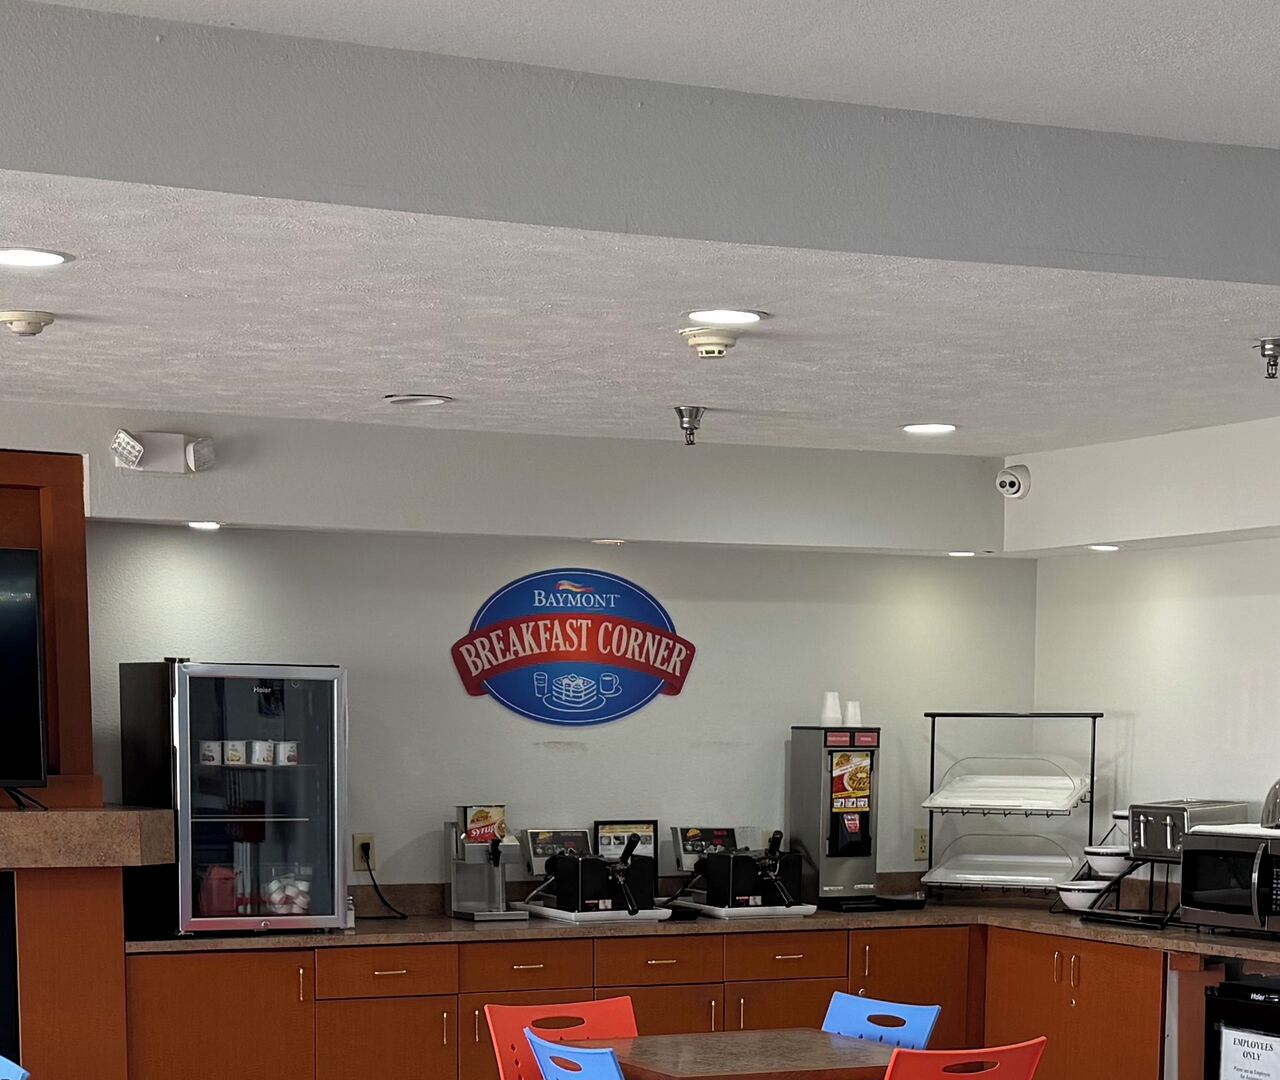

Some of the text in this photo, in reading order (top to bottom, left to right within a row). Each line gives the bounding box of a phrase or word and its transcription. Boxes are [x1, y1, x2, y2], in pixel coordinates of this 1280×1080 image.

[533, 590, 617, 607] BAYMONT
[458, 619, 688, 677] BREAKFAST CORNER
[1233, 1037, 1274, 1052] EMPLOYEES
[1242, 1050, 1261, 1061] ONLY
